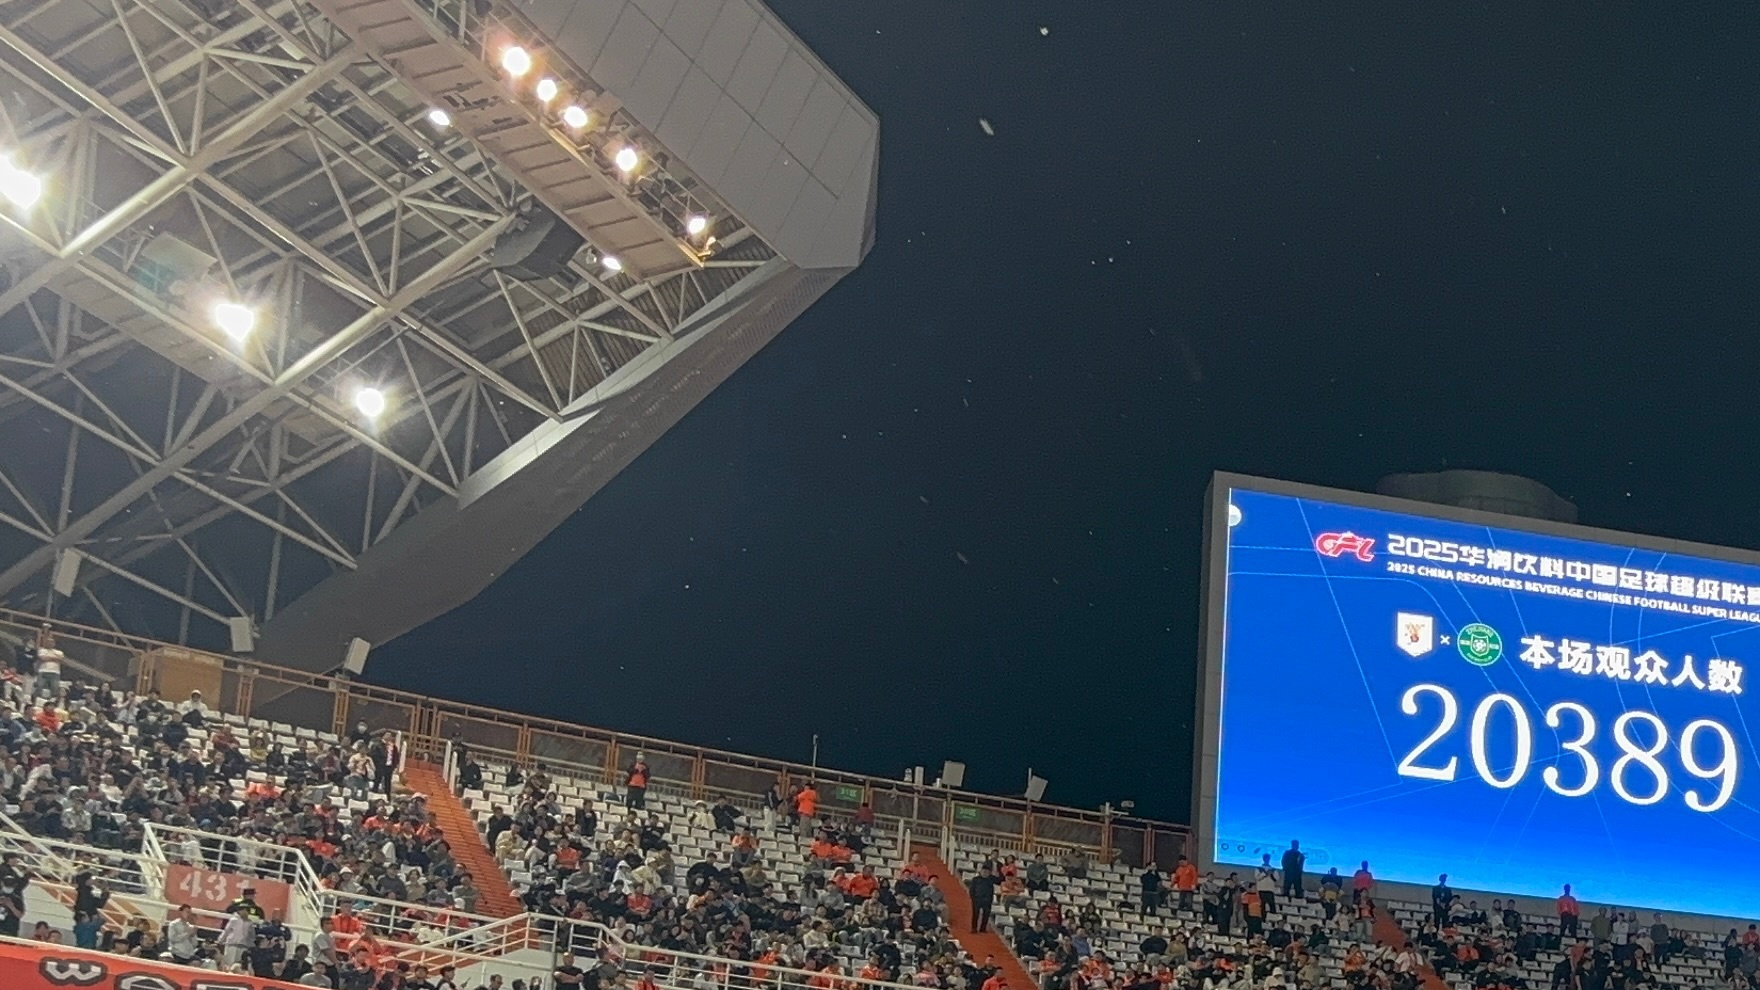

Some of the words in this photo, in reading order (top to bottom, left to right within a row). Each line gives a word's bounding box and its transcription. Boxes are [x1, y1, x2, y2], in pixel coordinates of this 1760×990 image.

[1387, 561, 1416, 575] 2025
[1417, 565, 1454, 580] CHINA
[1456, 571, 1524, 590] RESOURCES
[1525, 581, 1584, 599] BEVERAGE
[1586, 588, 1632, 606] CHINESE
[1634, 596, 1690, 614] FOOTBALL
[1691, 604, 1727, 619] SUPER
[1519, 634, 1744, 694] 本场观众人数
[1398, 683, 1738, 813] 20389
